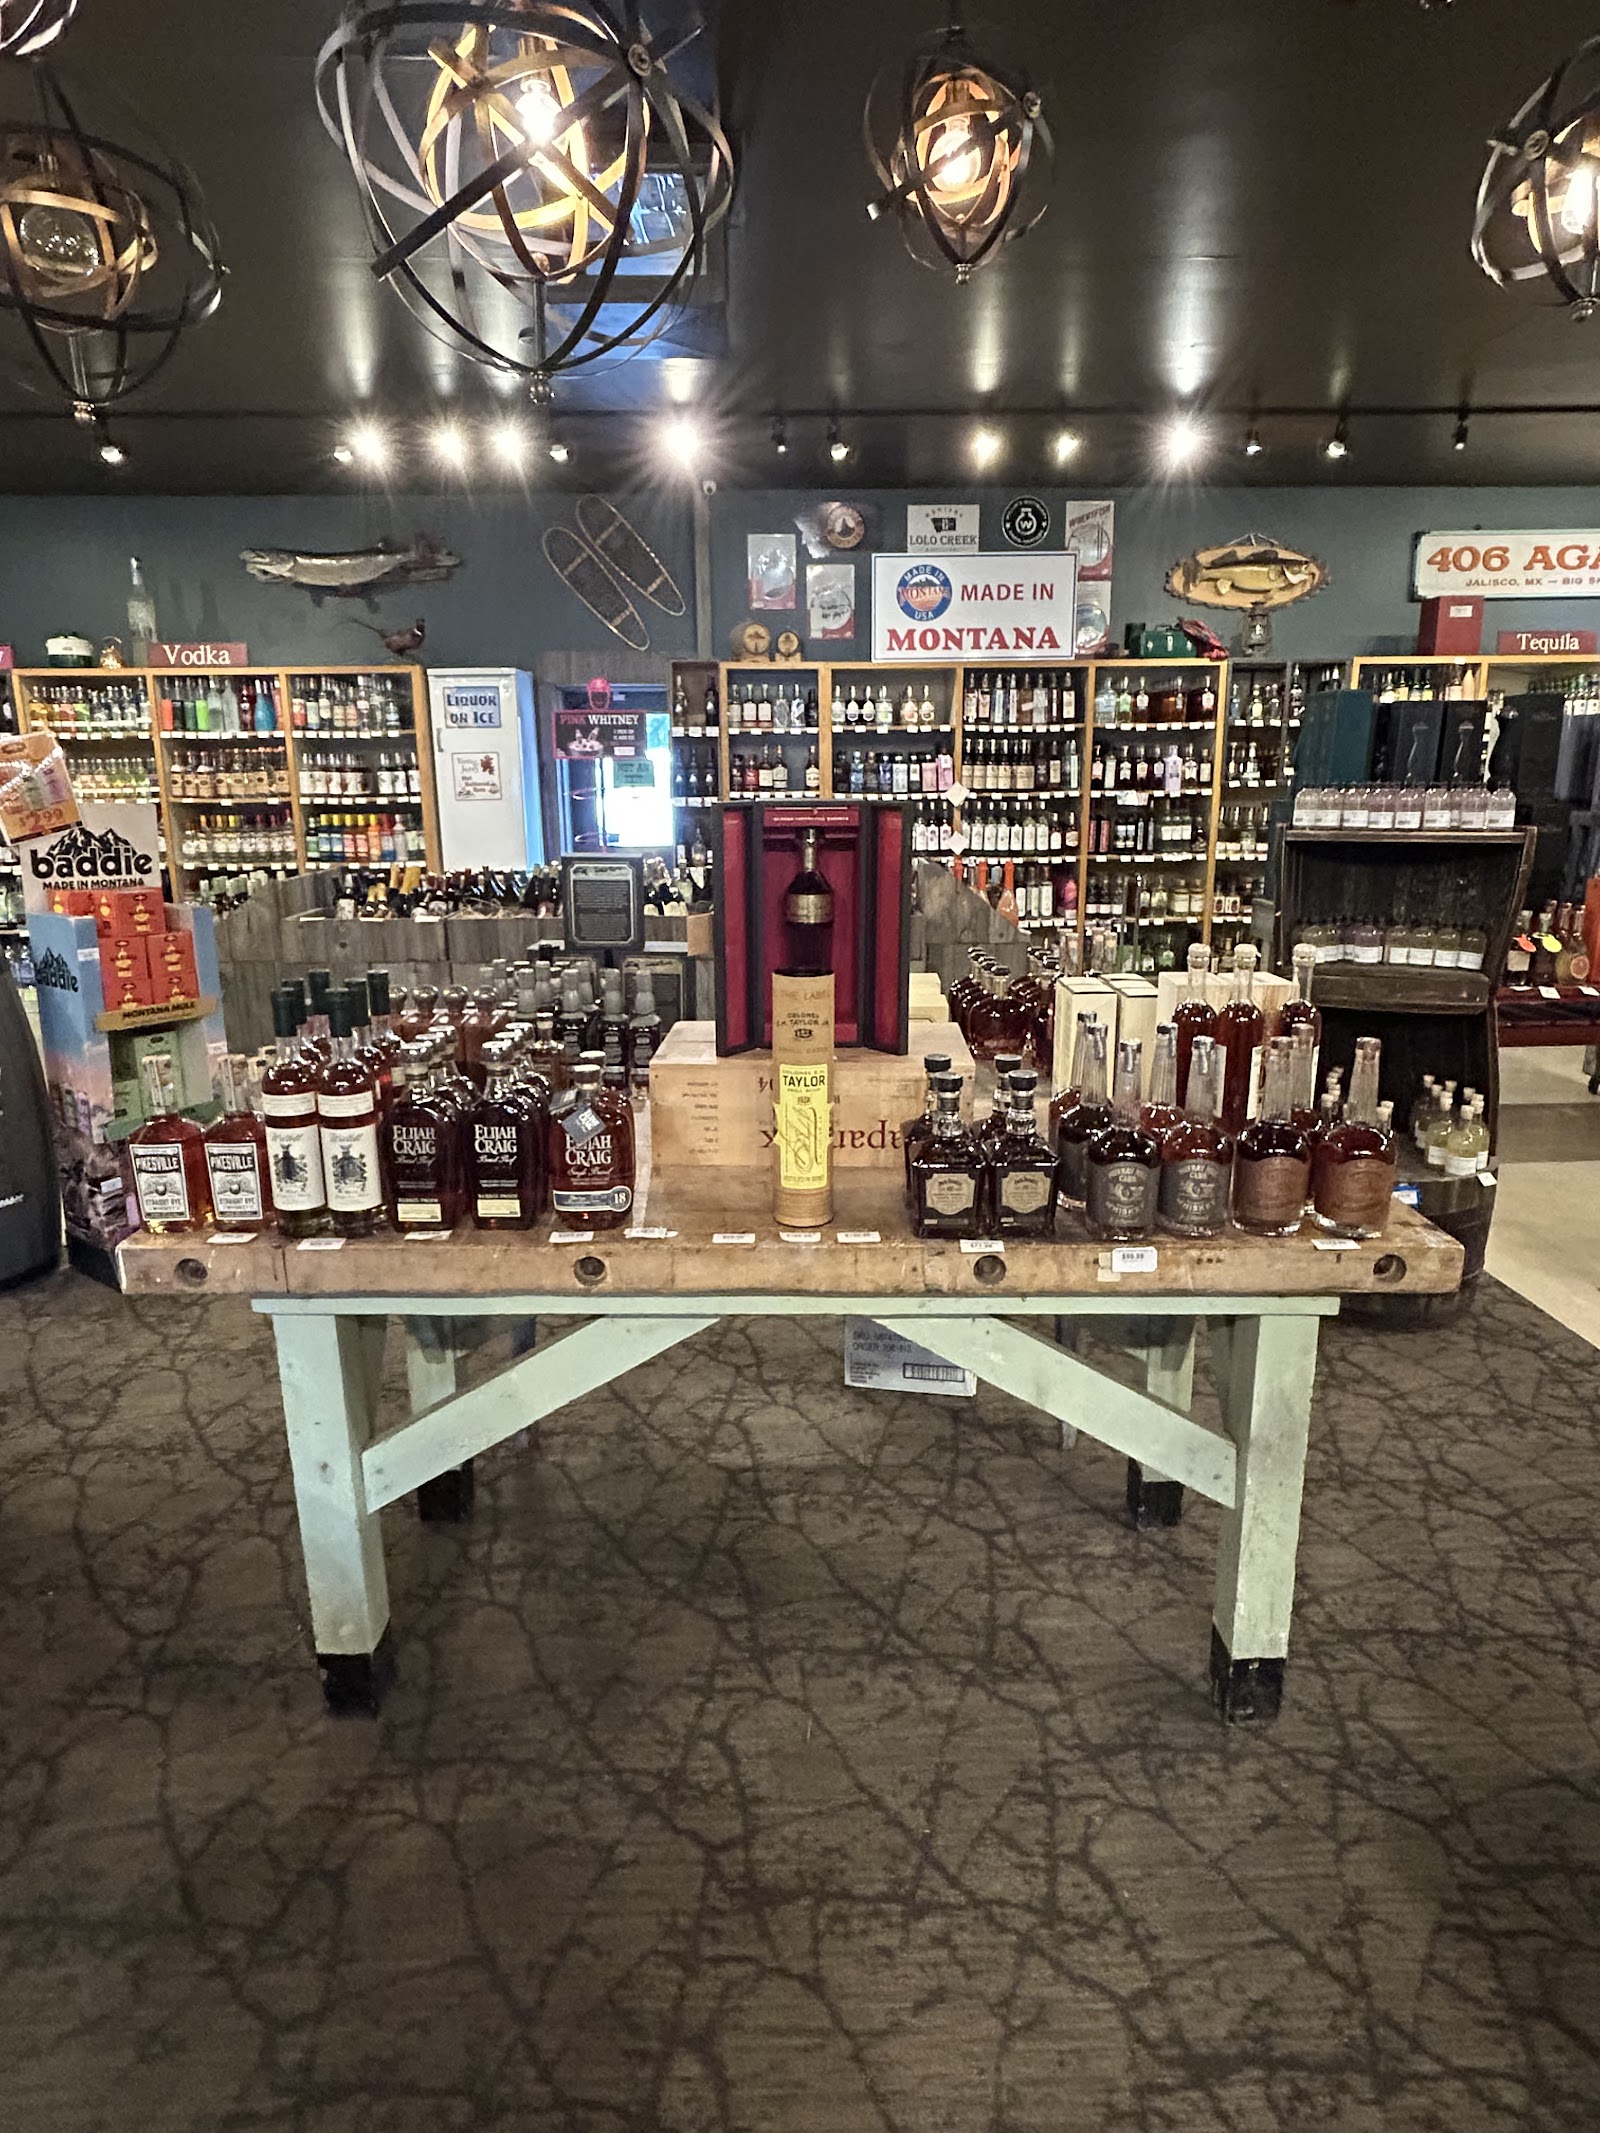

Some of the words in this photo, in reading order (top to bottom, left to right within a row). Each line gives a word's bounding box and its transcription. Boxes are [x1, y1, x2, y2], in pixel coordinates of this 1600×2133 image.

[909, 535, 937, 546] LOLO
[939, 535, 978, 546] CREEK
[1426, 545, 1510, 572] 406
[904, 566, 932, 581] MADE
[934, 569, 945, 582] IN
[1525, 578, 1542, 586] MX
[1562, 577, 1583, 585] BIG
[961, 583, 1024, 601] MADE
[1033, 583, 1054, 600] IN
[914, 610, 935, 620] USA
[887, 627, 1060, 651] MONTANA
[1516, 633, 1579, 654] Tequila
[163, 644, 231, 666] Vodka
[446, 694, 497, 706] LIQUOR
[473, 711, 495, 724] ICE
[560, 714, 586, 724] PINK
[588, 714, 639, 725] WHITNEY
[30, 846, 152, 879] baddie
[43, 880, 74, 890] MADE
[77, 880, 88, 889] IN
[91, 878, 145, 889] MONTANA
[123, 1005, 170, 1019] MONTANA
[171, 1001, 196, 1011] MULE
[782, 1075, 826, 1087] TAYLOR
[392, 1125, 436, 1140] ELIJAH
[473, 1124, 517, 1140] ELIJAH
[393, 1140, 436, 1155] CRAIG
[474, 1140, 517, 1154] CRAIG
[135, 1155, 179, 1170] PIKESVILLE
[210, 1155, 254, 1170] PIKESVILLE
[565, 1149, 612, 1167] CRAIG
[613, 1193, 626, 1204] 18
